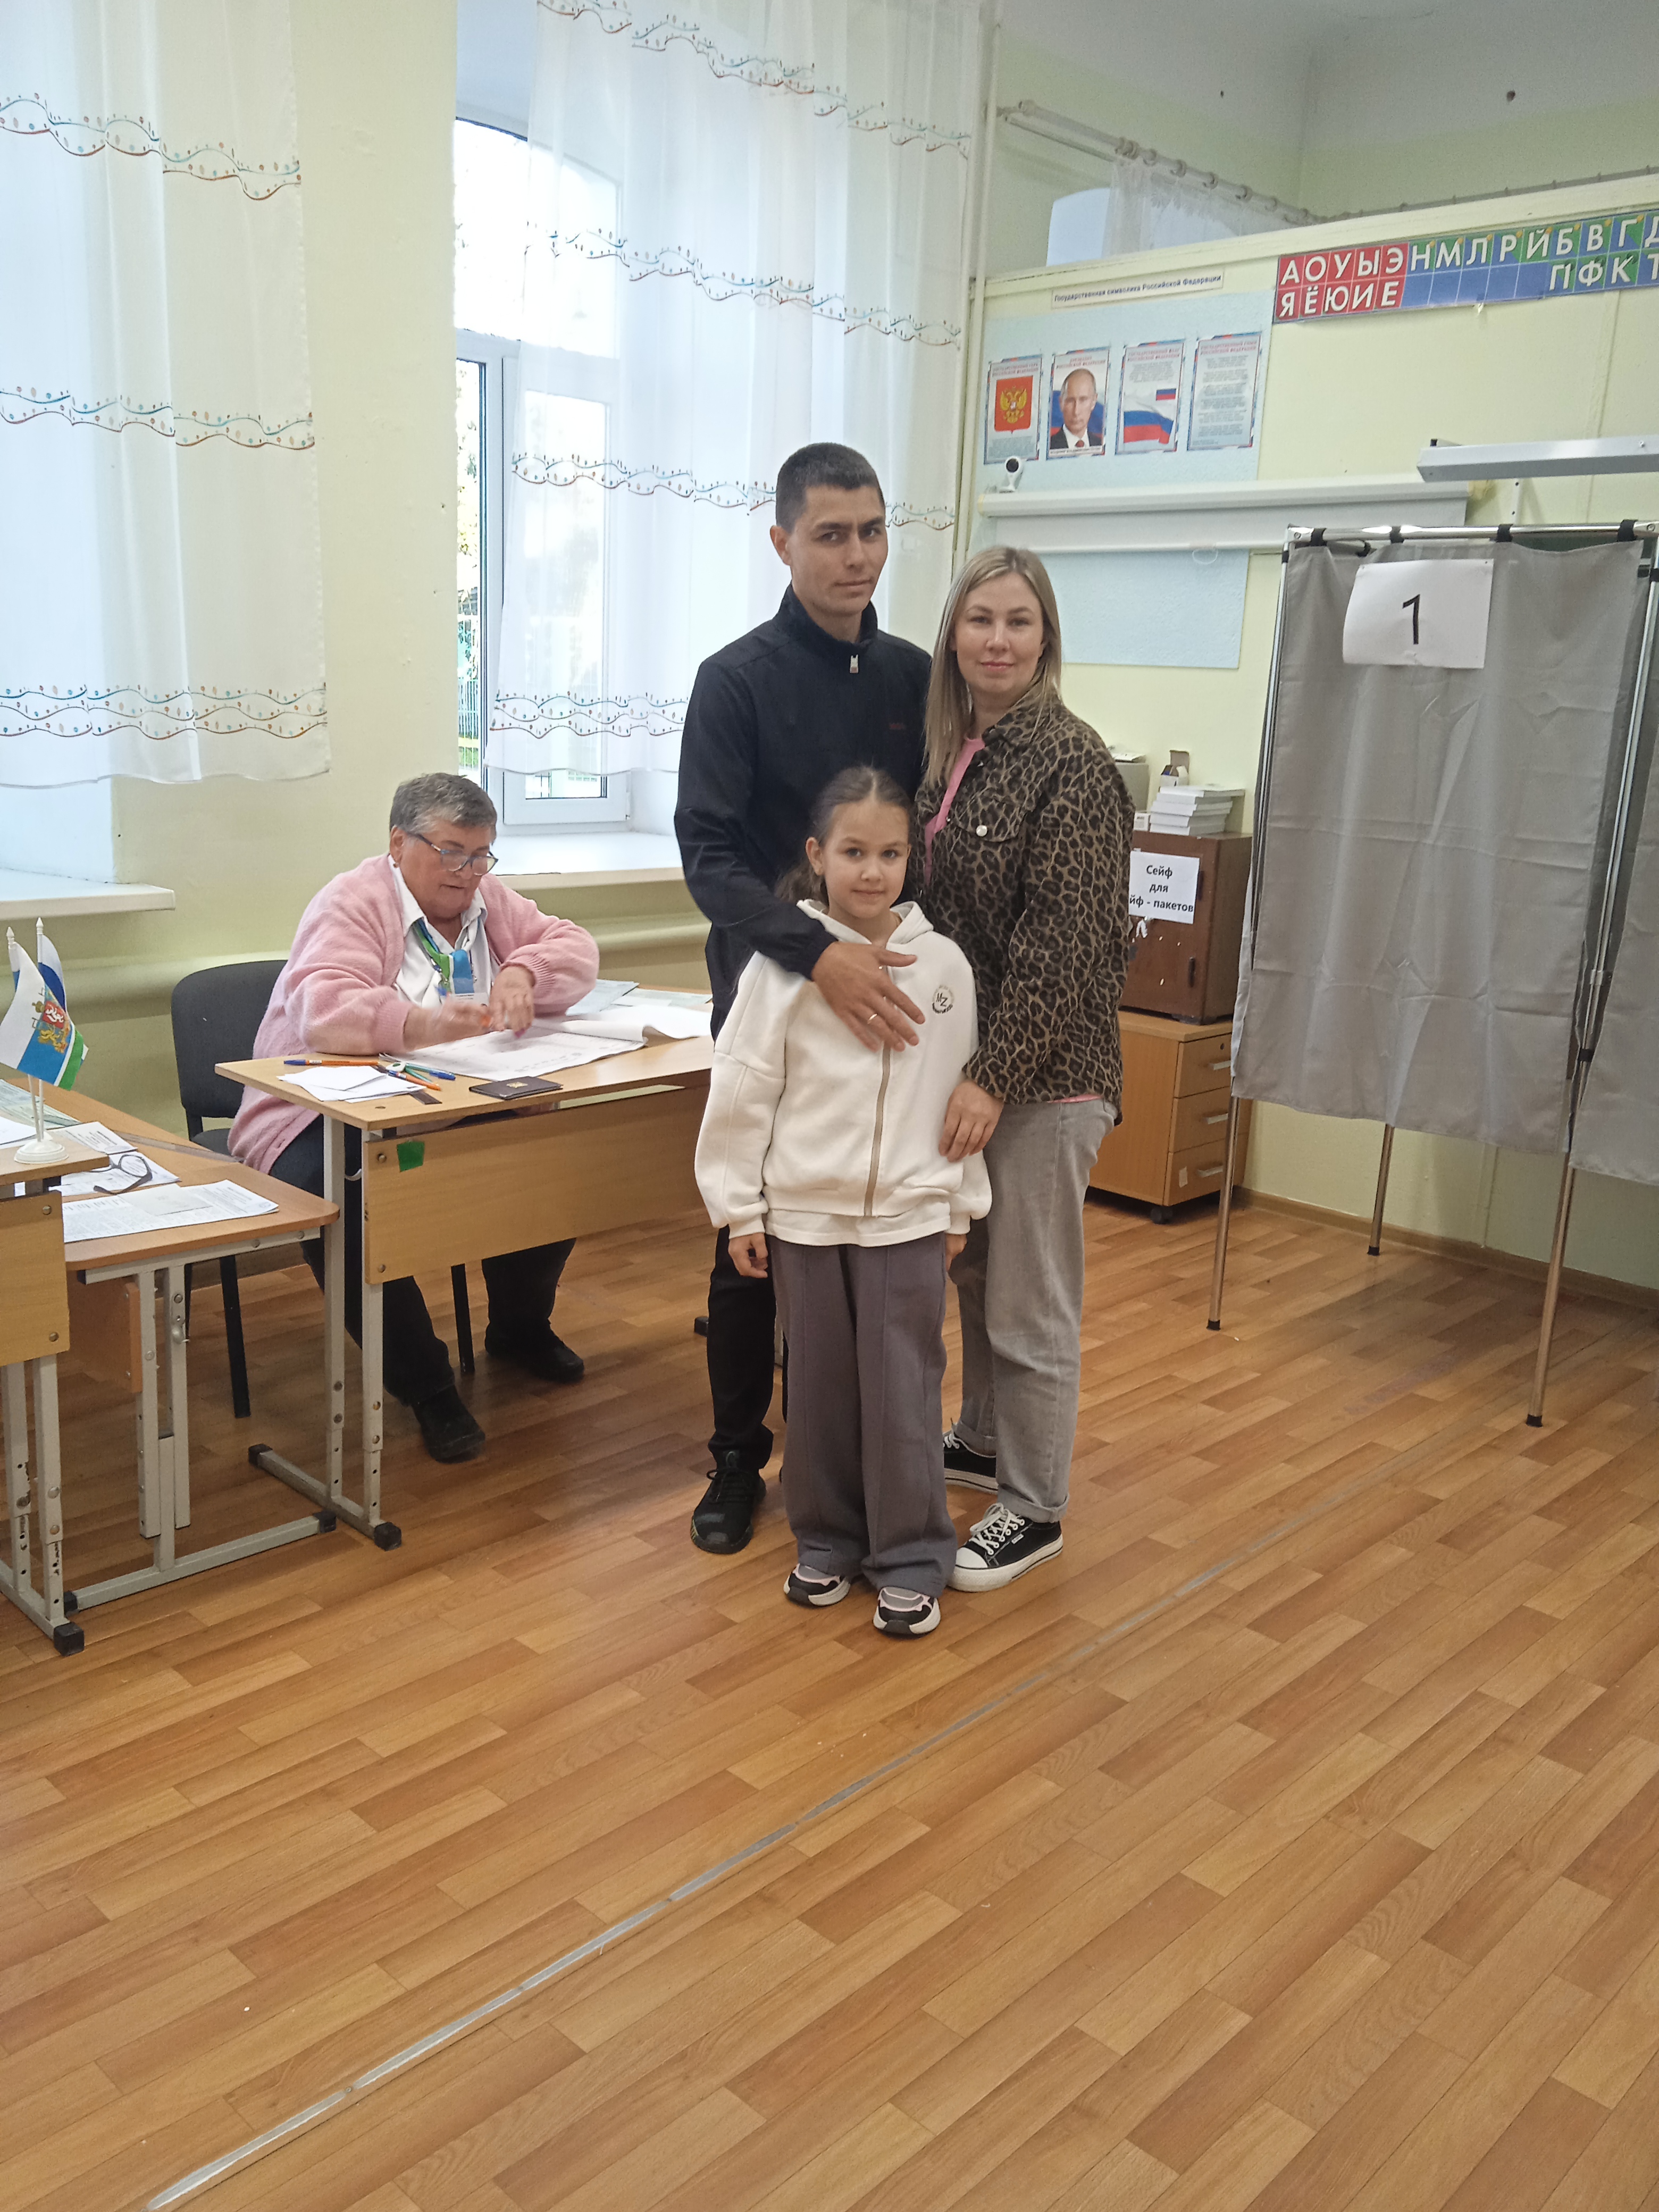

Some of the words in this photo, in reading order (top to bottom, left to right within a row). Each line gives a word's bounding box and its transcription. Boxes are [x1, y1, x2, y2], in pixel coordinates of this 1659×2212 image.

[1143, 279, 1181, 290] Российской
[1183, 275, 1221, 286] Федерации
[1402, 594, 1420, 645] 1
[1146, 865, 1172, 879] Сейф
[1149, 884, 1168, 893] для
[1129, 894, 1144, 908] йф
[1153, 900, 1194, 912] пакетов
